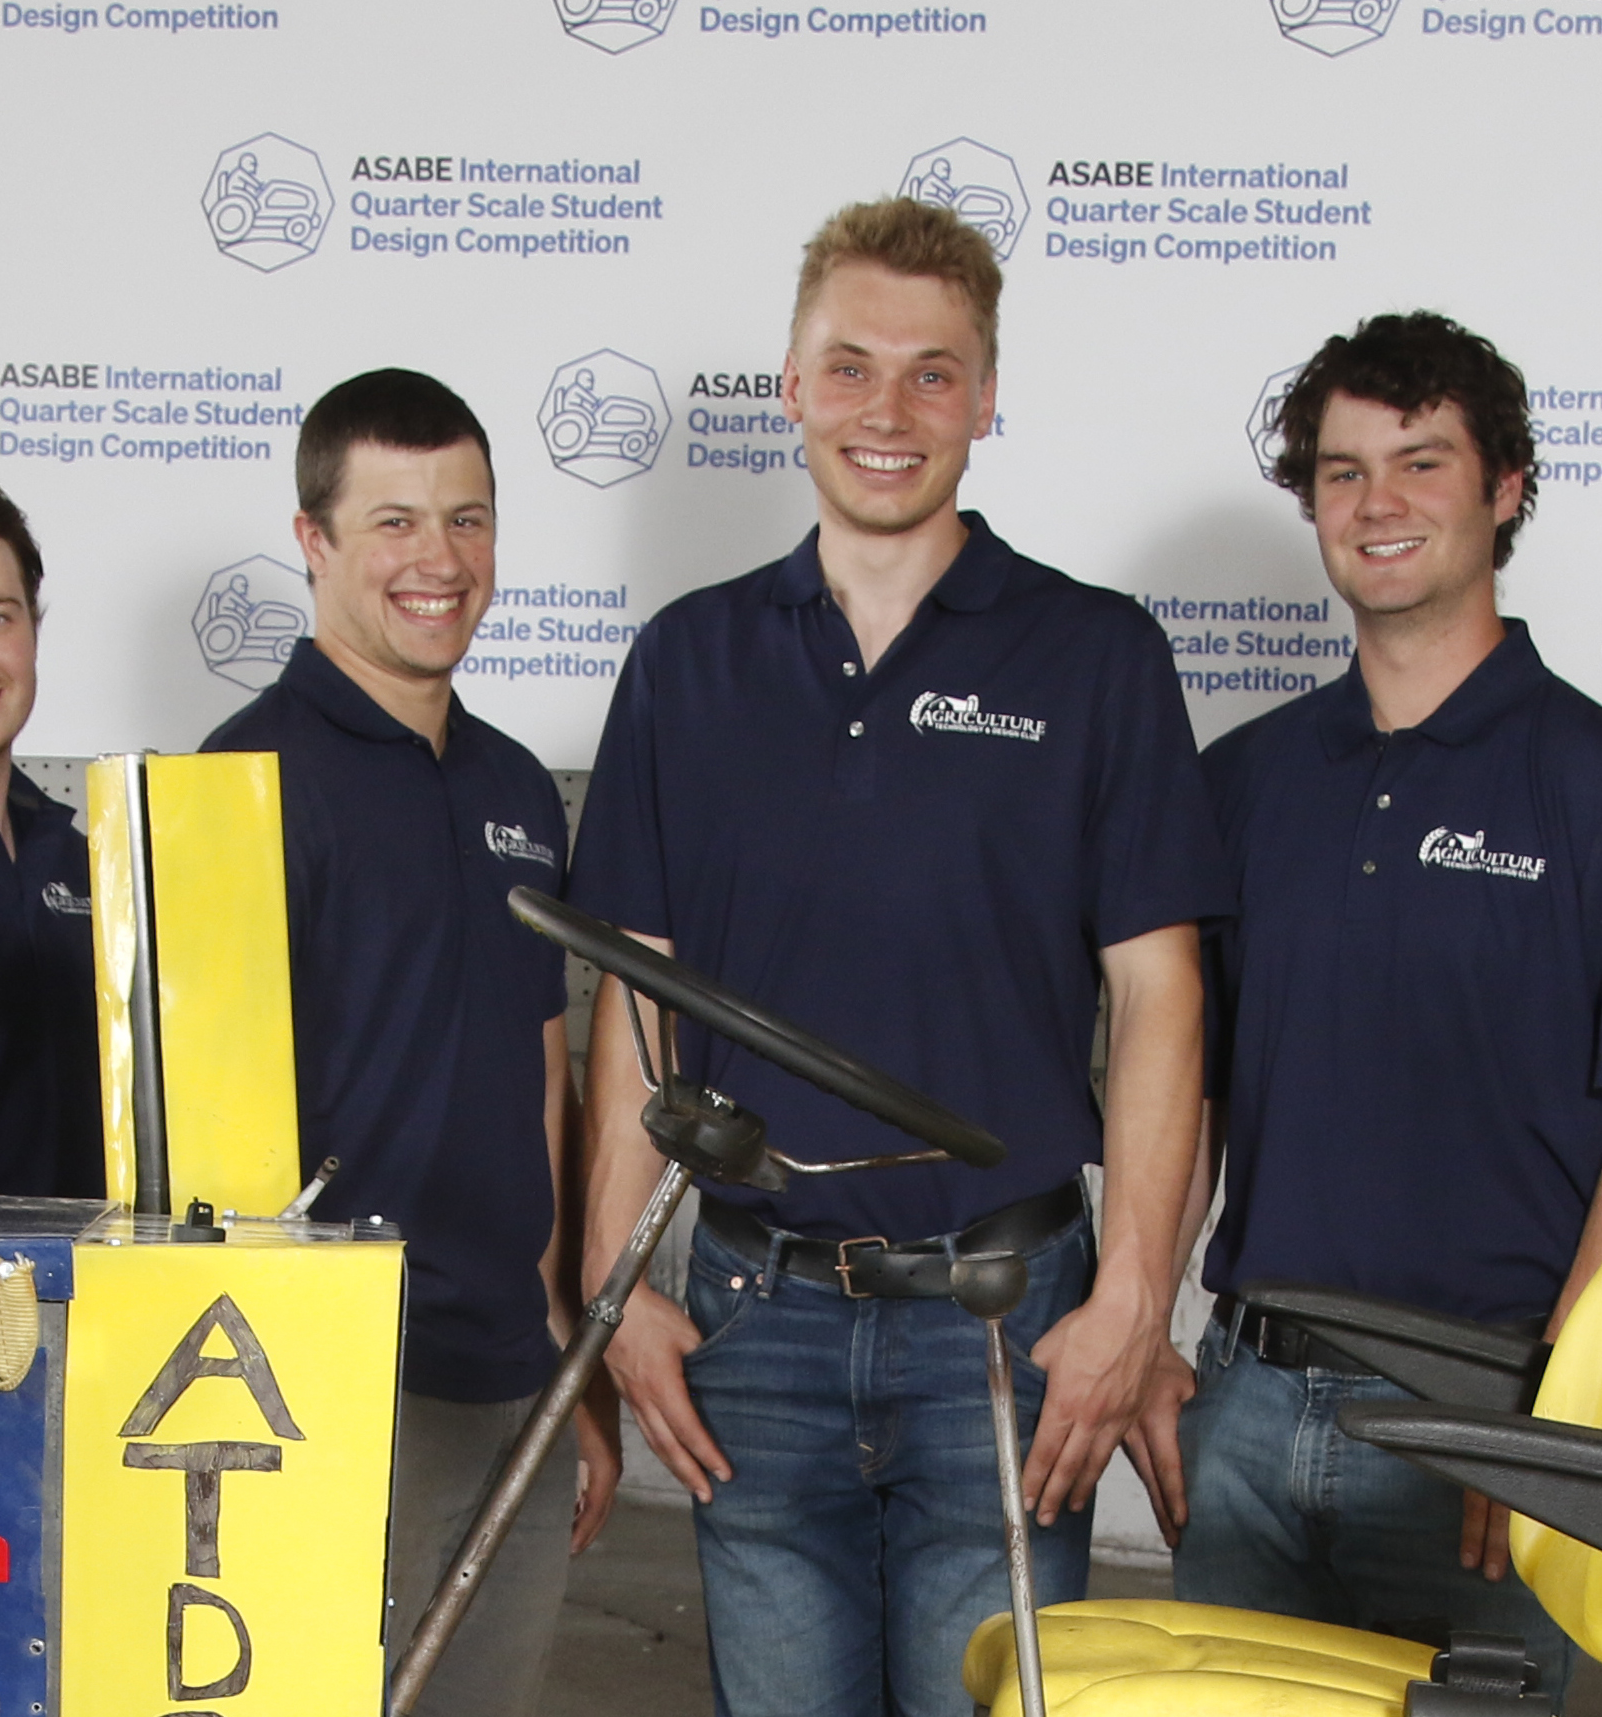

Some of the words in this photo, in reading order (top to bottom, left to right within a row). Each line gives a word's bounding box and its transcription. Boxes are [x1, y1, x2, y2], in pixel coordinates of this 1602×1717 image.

[2, 2, 98, 34] Design
[105, 2, 278, 34] Competition
[700, 6, 800, 39] Design
[807, 6, 986, 38] Competition
[1422, 8, 1526, 41] Design
[351, 155, 454, 183] ASABE
[460, 157, 640, 184] International
[1047, 160, 1154, 188] ASABE
[1161, 162, 1348, 189] International
[350, 190, 462, 220] Quarter
[467, 192, 545, 218] Scale
[550, 193, 663, 219] Student
[1046, 196, 1162, 226] Quarter
[1167, 197, 1248, 224] Scale
[1254, 198, 1372, 225] Student
[351, 225, 448, 258] Design
[455, 227, 629, 258] Competition
[1046, 231, 1147, 265] Design
[1154, 233, 1336, 265] Competition
[0, 363, 99, 389] ASABE
[106, 365, 282, 392] International
[112, 399, 189, 425] Scale
[194, 400, 304, 426] Student
[0, 431, 94, 463] Design
[100, 433, 271, 464] Competition
[688, 442, 786, 474] Design
[473, 616, 531, 640] cale
[537, 617, 647, 643] Studen
[1168, 630, 1229, 654] cale
[1236, 630, 1353, 658] Student
[452, 652, 617, 680] ompetition
[1177, 667, 1318, 696] mpetition
[919, 709, 1047, 735] AGRICULTURE
[1428, 846, 1546, 874] AGRICULTURE
